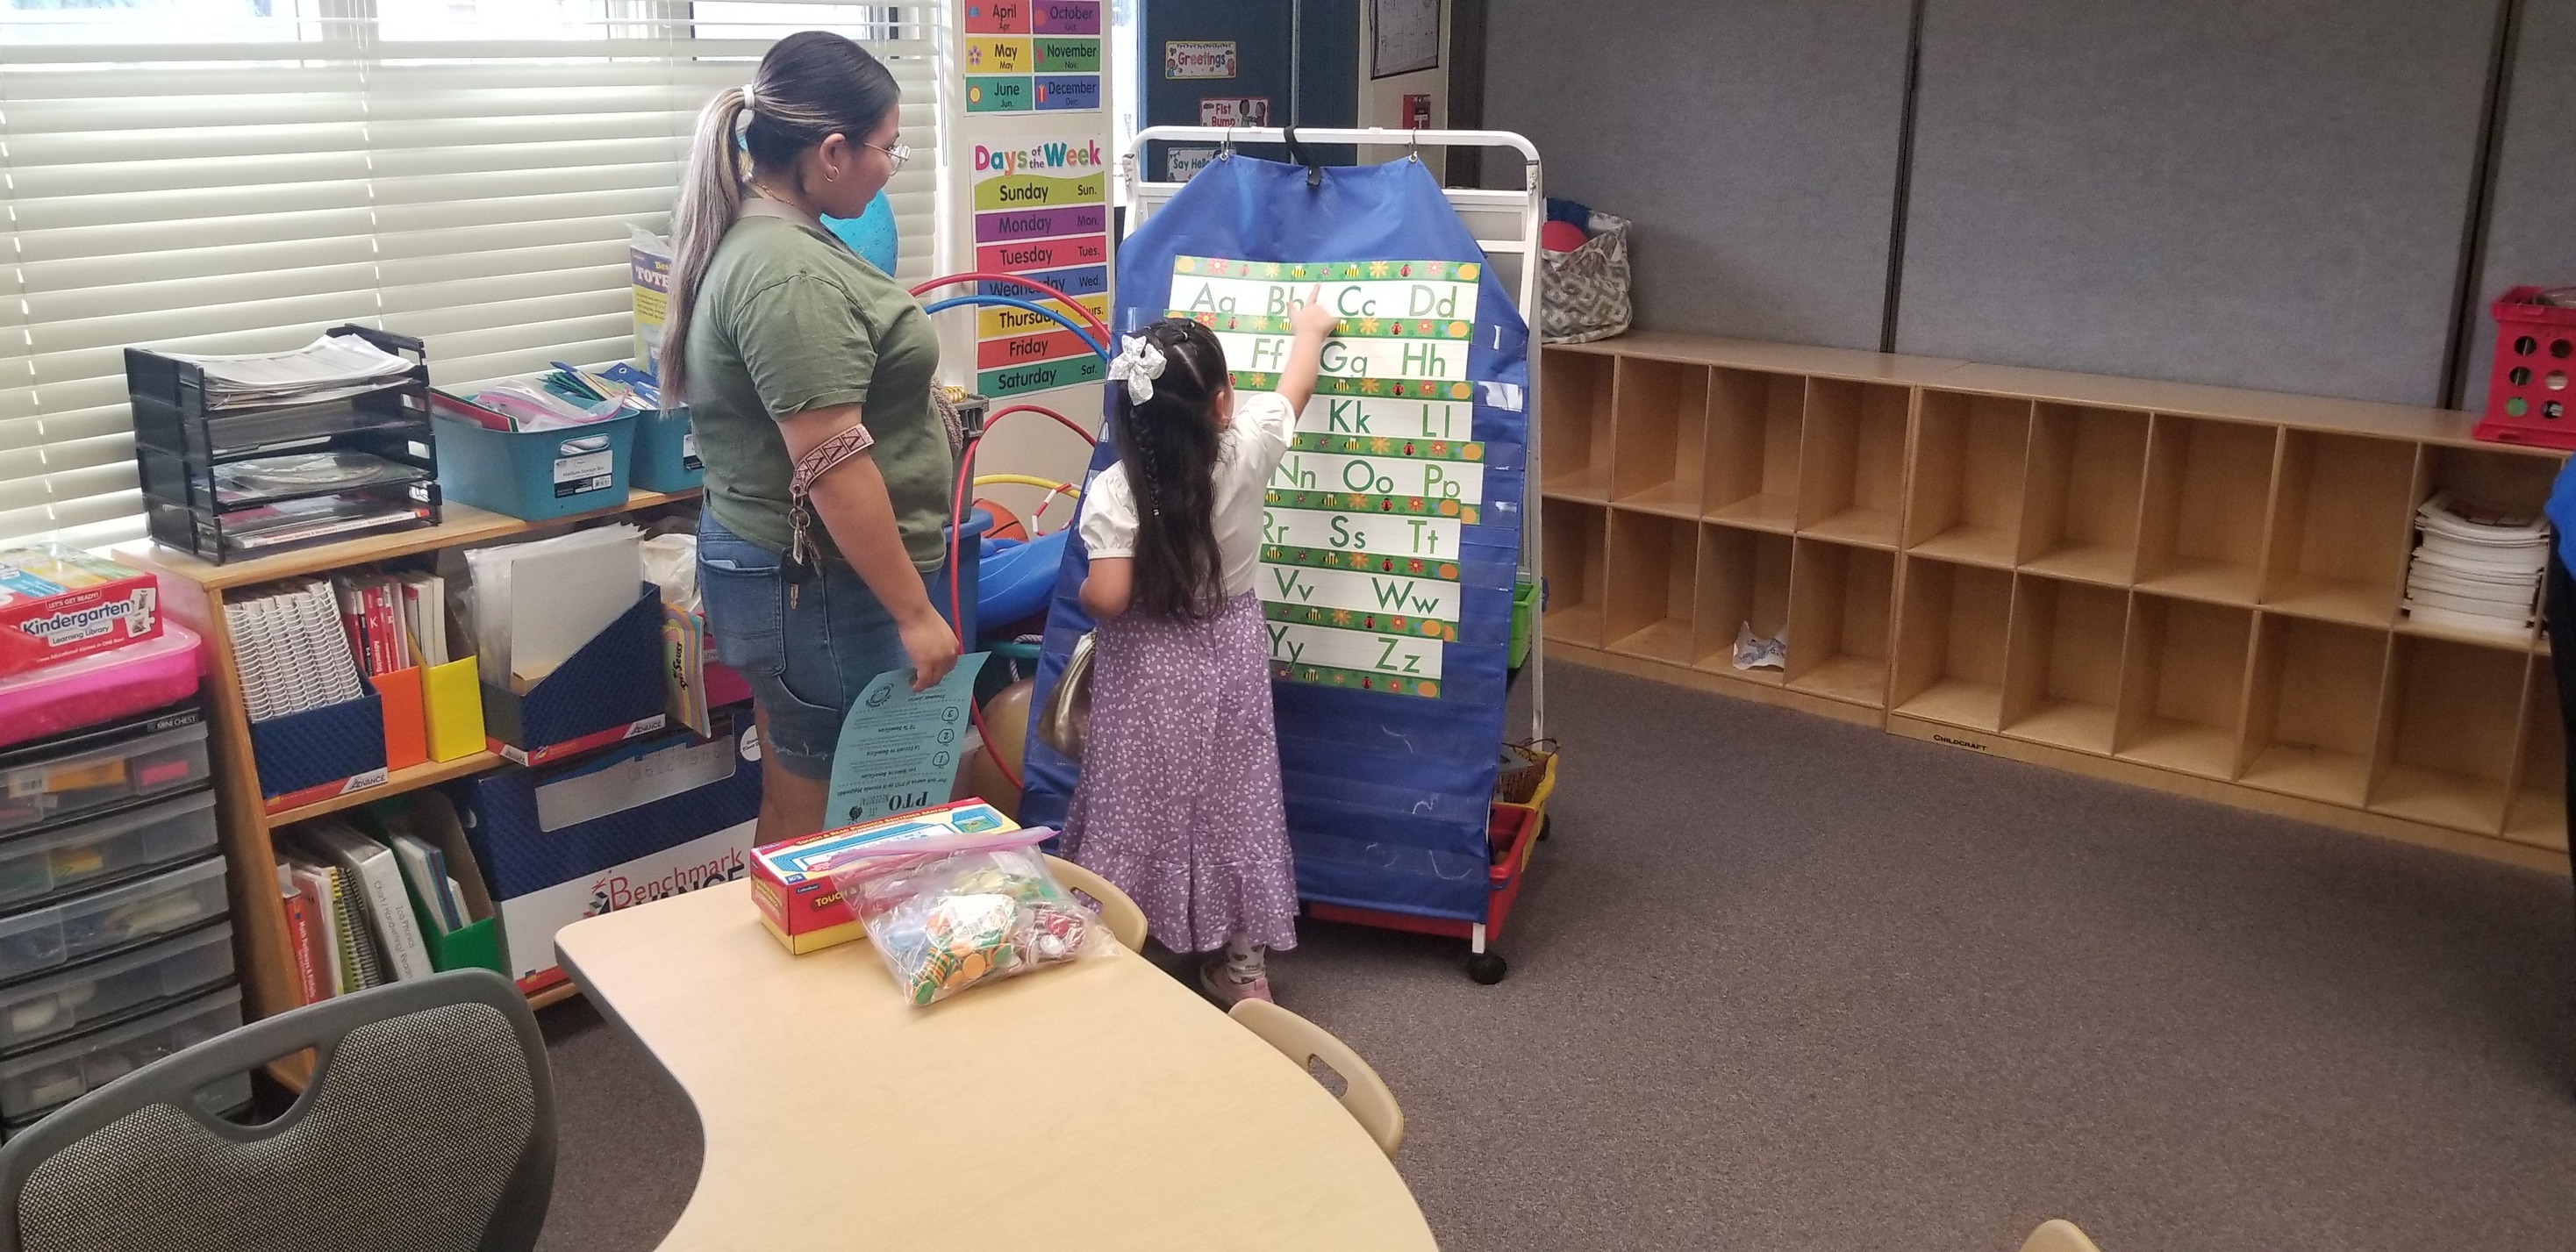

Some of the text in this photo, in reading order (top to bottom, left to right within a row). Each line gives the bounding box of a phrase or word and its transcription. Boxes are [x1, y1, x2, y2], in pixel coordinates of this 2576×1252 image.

[992, 4, 1017, 23] April
[1050, 5, 1093, 19] October
[994, 44, 1018, 61] May
[1047, 44, 1097, 58] November
[1177, 52, 1226, 68] Greetings
[999, 61, 1013, 71] May
[994, 82, 1020, 96] June
[1048, 82, 1097, 94] December
[1000, 99, 1014, 108] Jun.
[1215, 103, 1232, 115] Fist
[1211, 116, 1236, 127] Bump
[975, 140, 1102, 177] Days of the Week
[1173, 159, 1189, 171] Say
[999, 182, 1097, 204] Sunday Sun.
[998, 215, 1099, 233] Monday Mon.
[999, 246, 1100, 265] Tuesday Tues.
[1079, 275, 1101, 287] Wed.
[1190, 283, 1236, 314] Aa
[1338, 285, 1376, 317] Cc
[1409, 285, 1457, 318] Dd
[1010, 339, 1048, 357] Friday
[1251, 338, 1446, 377] Ff Gg Hh
[998, 365, 1097, 390] Saturday Sat.
[1329, 399, 1450, 439] Kk Ll
[1270, 455, 1461, 497] Nn Oo Pp
[1329, 515, 1366, 549] Ss
[1407, 519, 1438, 554] Tt
[77, 592, 98, 602] READY!
[1273, 568, 1440, 615] Vv Ww
[23, 602, 131, 635] Kindergarten
[369, 617, 378, 628] K
[53, 626, 110, 644] Learning Library
[373, 640, 383, 672] Advancing
[673, 641, 683, 673] Seuss
[1267, 624, 1421, 674] Yy Zz
[174, 715, 196, 727] CHEST
[1933, 733, 1987, 751] CHILDCRAFT
[350, 775, 386, 790] ADVANCE
[888, 791, 928, 811] PTO
[796, 835, 822, 846] TOUCH
[610, 847, 744, 911] Benchmark
[403, 919, 415, 948] Phonics
